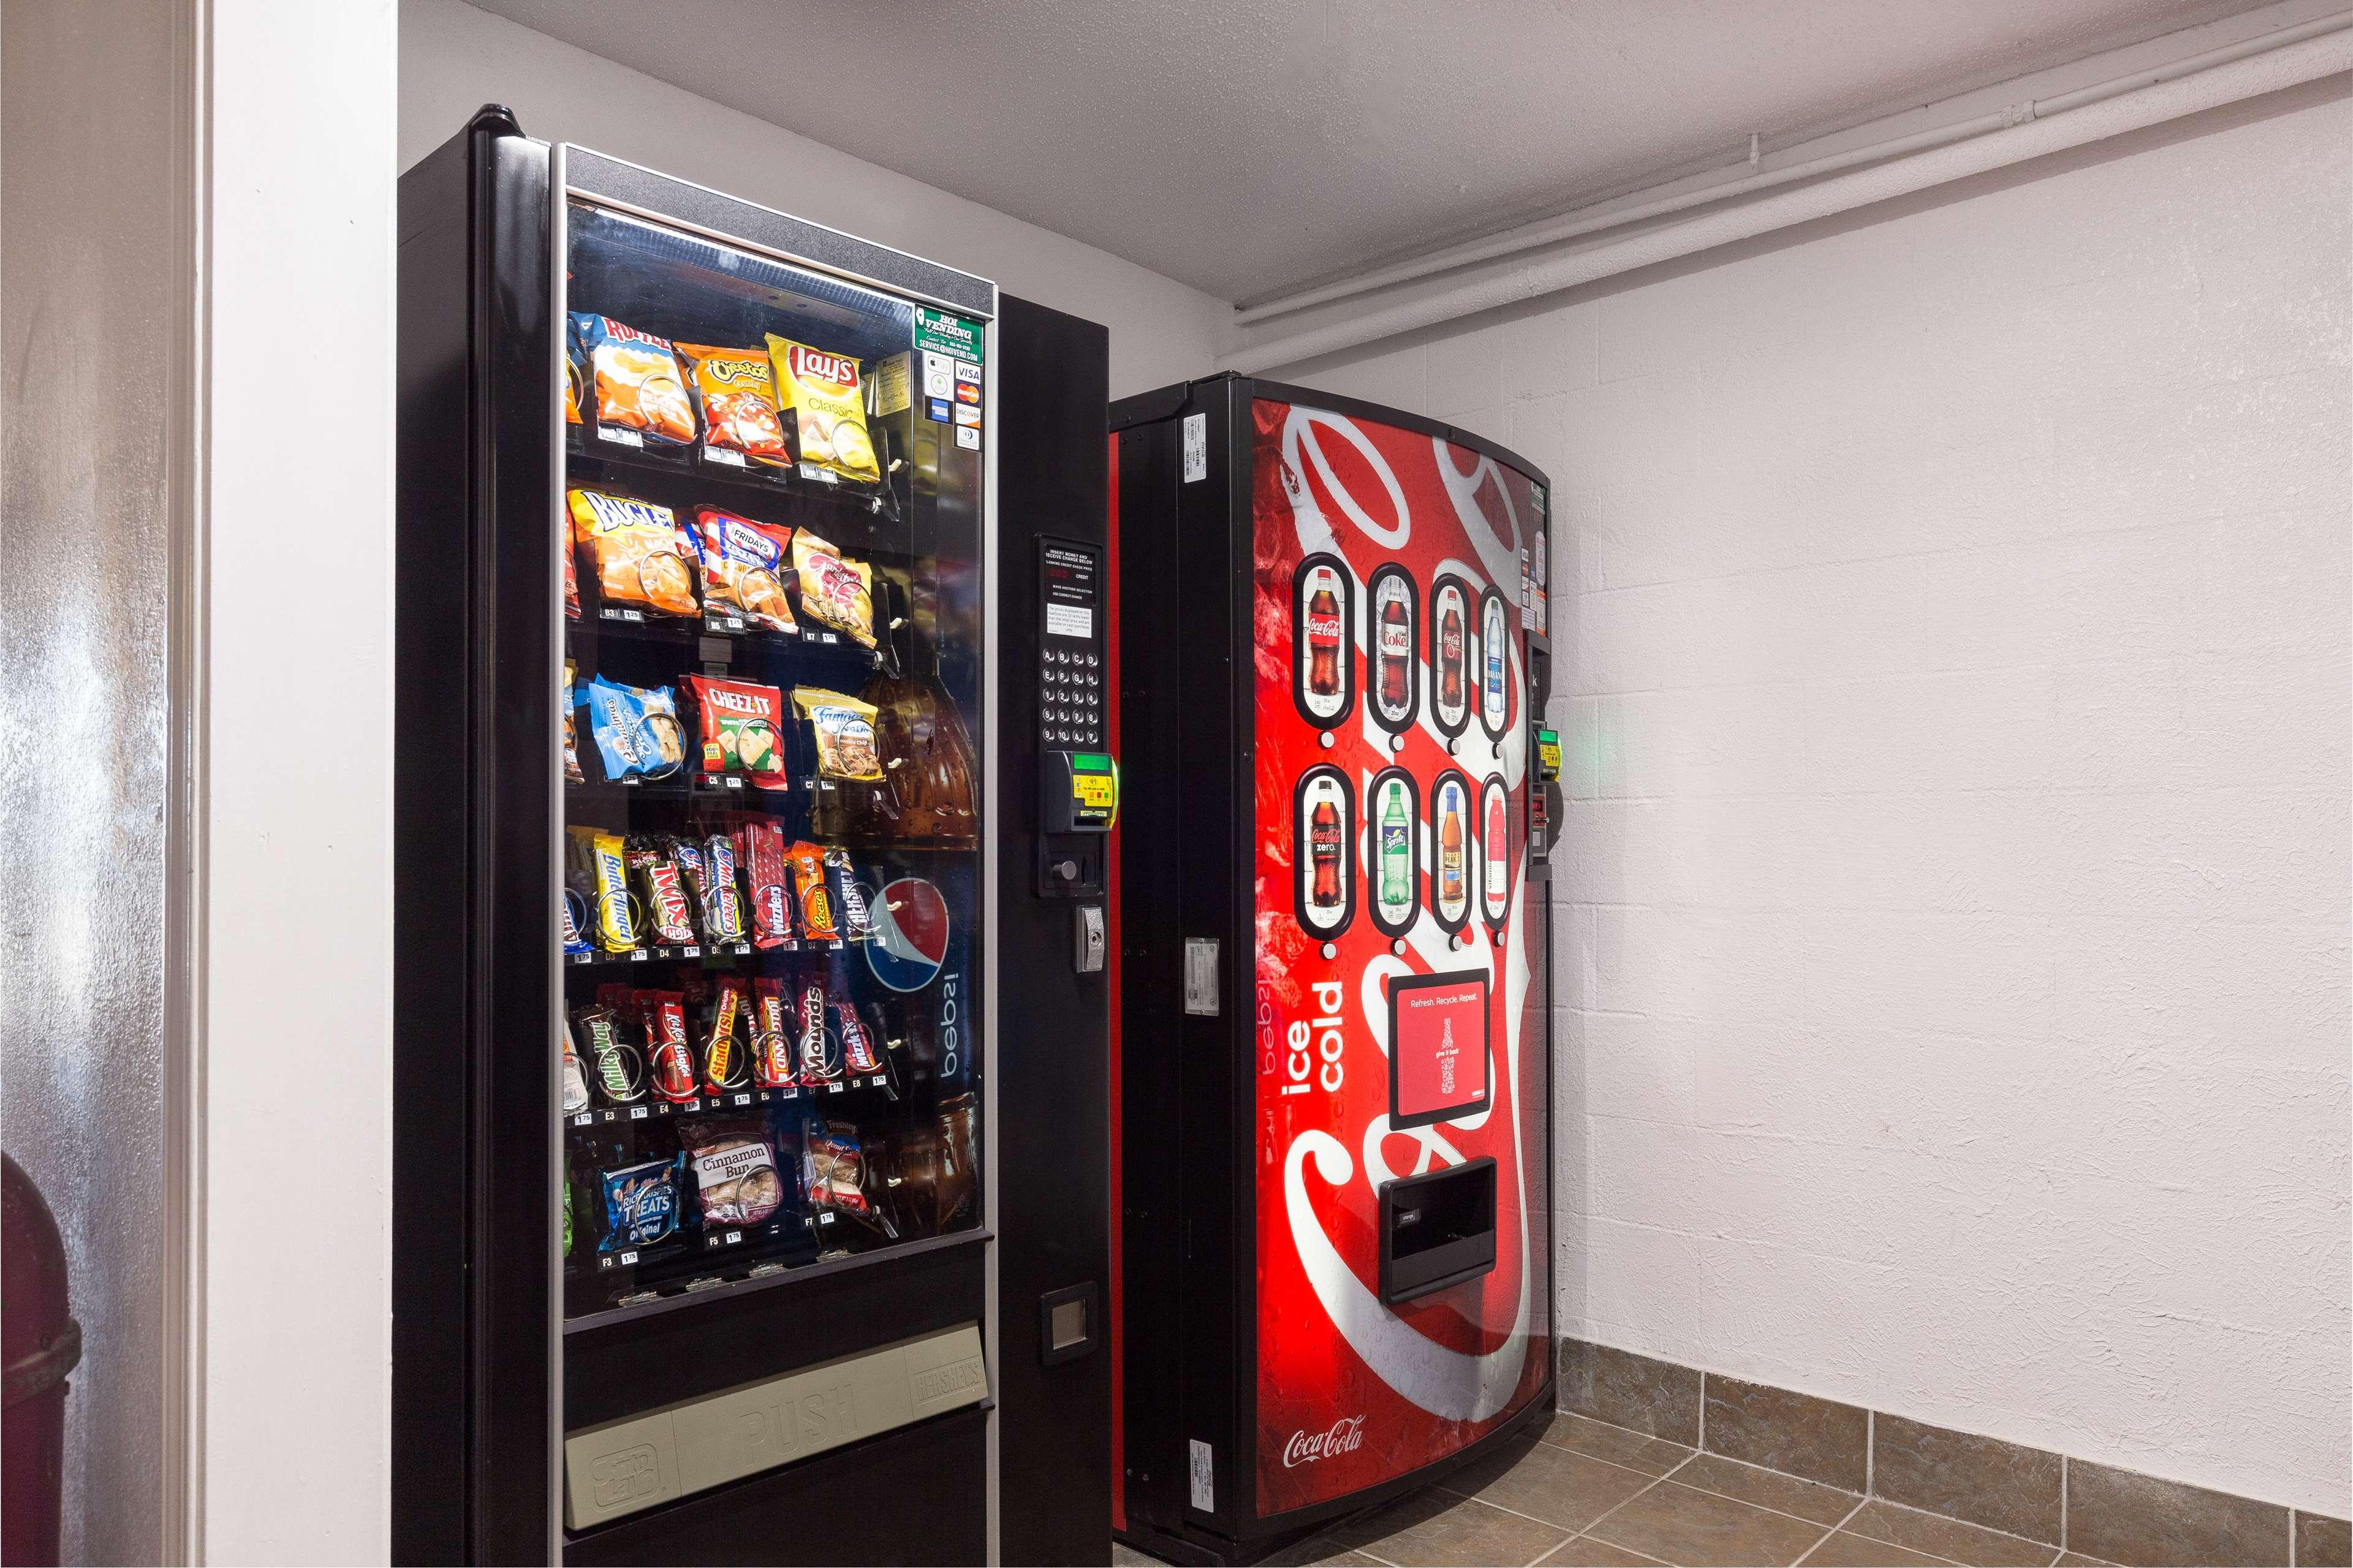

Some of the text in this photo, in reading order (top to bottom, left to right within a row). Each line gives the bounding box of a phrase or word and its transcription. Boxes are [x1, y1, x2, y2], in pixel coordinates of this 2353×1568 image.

[925, 319, 972, 339] VENDING
[939, 314, 958, 327] HOI
[919, 339, 978, 362] SERVICE@HOIVEND.COM
[710, 360, 769, 382] Cheetos
[797, 347, 852, 384] Lay's
[958, 366, 980, 381] VISA
[734, 379, 762, 390] Crunchy
[957, 388, 980, 398] MasterCard
[808, 398, 853, 420] Classic
[957, 408, 980, 419] DISCOVER
[734, 529, 769, 552] FRIDAYS
[711, 621, 721, 630] B5
[1308, 618, 1339, 638] Coca-Cola
[1383, 631, 1406, 647] Coke
[708, 687, 771, 716] CHEEZ-IT
[1312, 828, 1340, 844] Coca-Cola
[1386, 833, 1404, 849] Sprite
[602, 853, 632, 941] Butterfinger
[650, 860, 690, 926] TWIX
[814, 889, 827, 930] Reese's
[1411, 993, 1477, 1008] Refresh. Recycle. Repeat.
[803, 987, 826, 1077] Mounds
[1311, 980, 1343, 1093] cold
[711, 1012, 732, 1077] Starburst
[592, 1021, 629, 1091] Milky Way
[1281, 1020, 1311, 1096] ice
[1436, 1050, 1446, 1059] give
[577, 1115, 590, 1124] 175
[605, 1112, 615, 1120] E3
[634, 1108, 645, 1117] 175
[702, 1147, 766, 1172] Cinnamon
[725, 1164, 750, 1179] Bun
[643, 1185, 673, 1199] RISPIES
[623, 1195, 671, 1223] TREATS
[630, 1222, 661, 1241] Orginal
[728, 1233, 740, 1242] 175
[709, 1237, 718, 1246] F5
[602, 1257, 612, 1267] F3
[623, 1253, 636, 1263] 175
[918, 1359, 981, 1402] HERSHEY'S
[738, 1383, 858, 1468] PUSH
[1283, 1413, 1367, 1468] Coca-Cola
